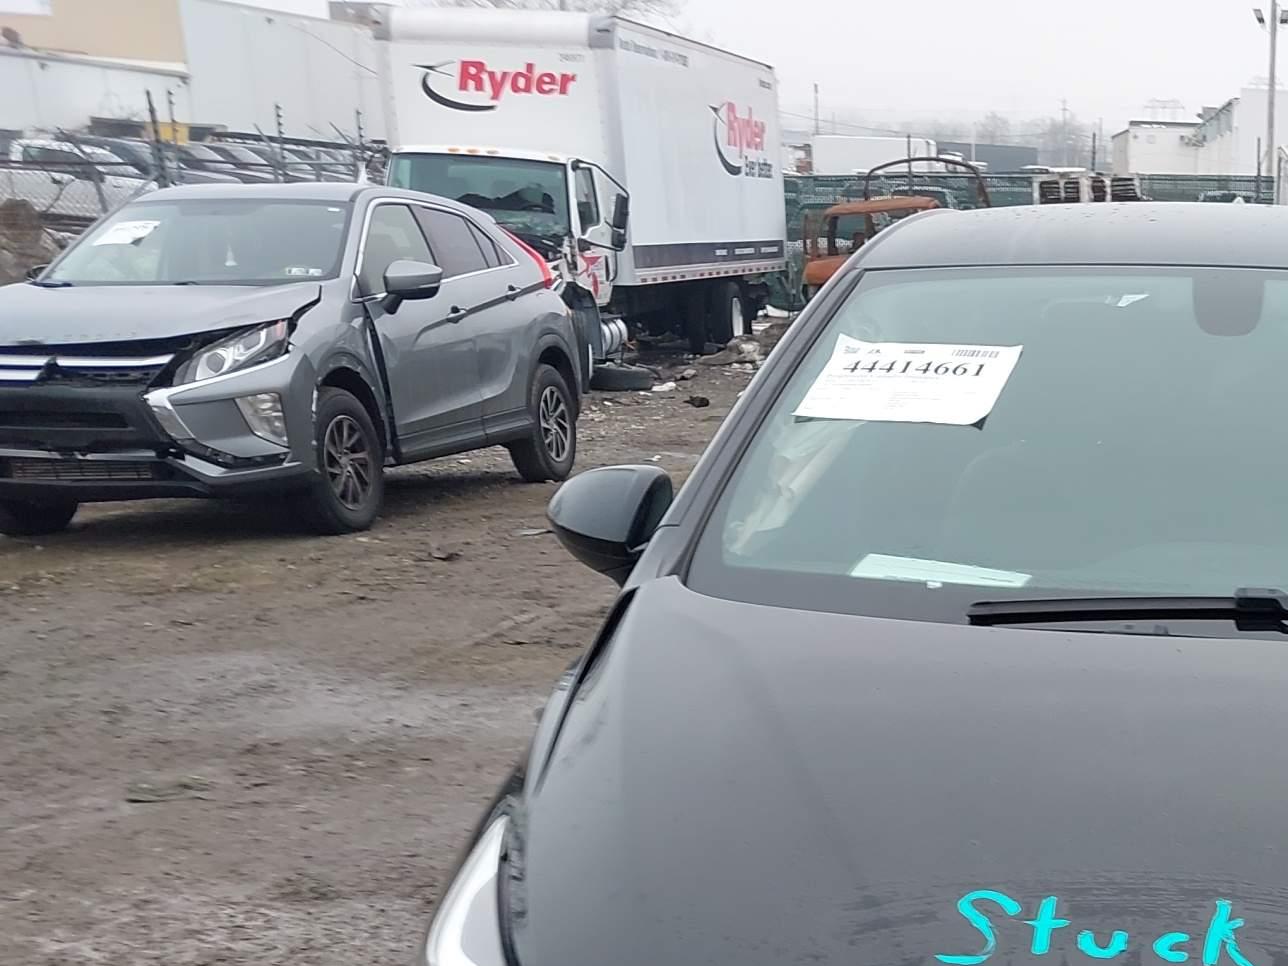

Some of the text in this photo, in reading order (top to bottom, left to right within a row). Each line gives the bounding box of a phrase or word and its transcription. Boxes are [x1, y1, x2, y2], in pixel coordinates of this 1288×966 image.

[458, 60, 577, 101] Ryder
[727, 101, 766, 159] Ryder
[843, 359, 986, 377] 44414661
